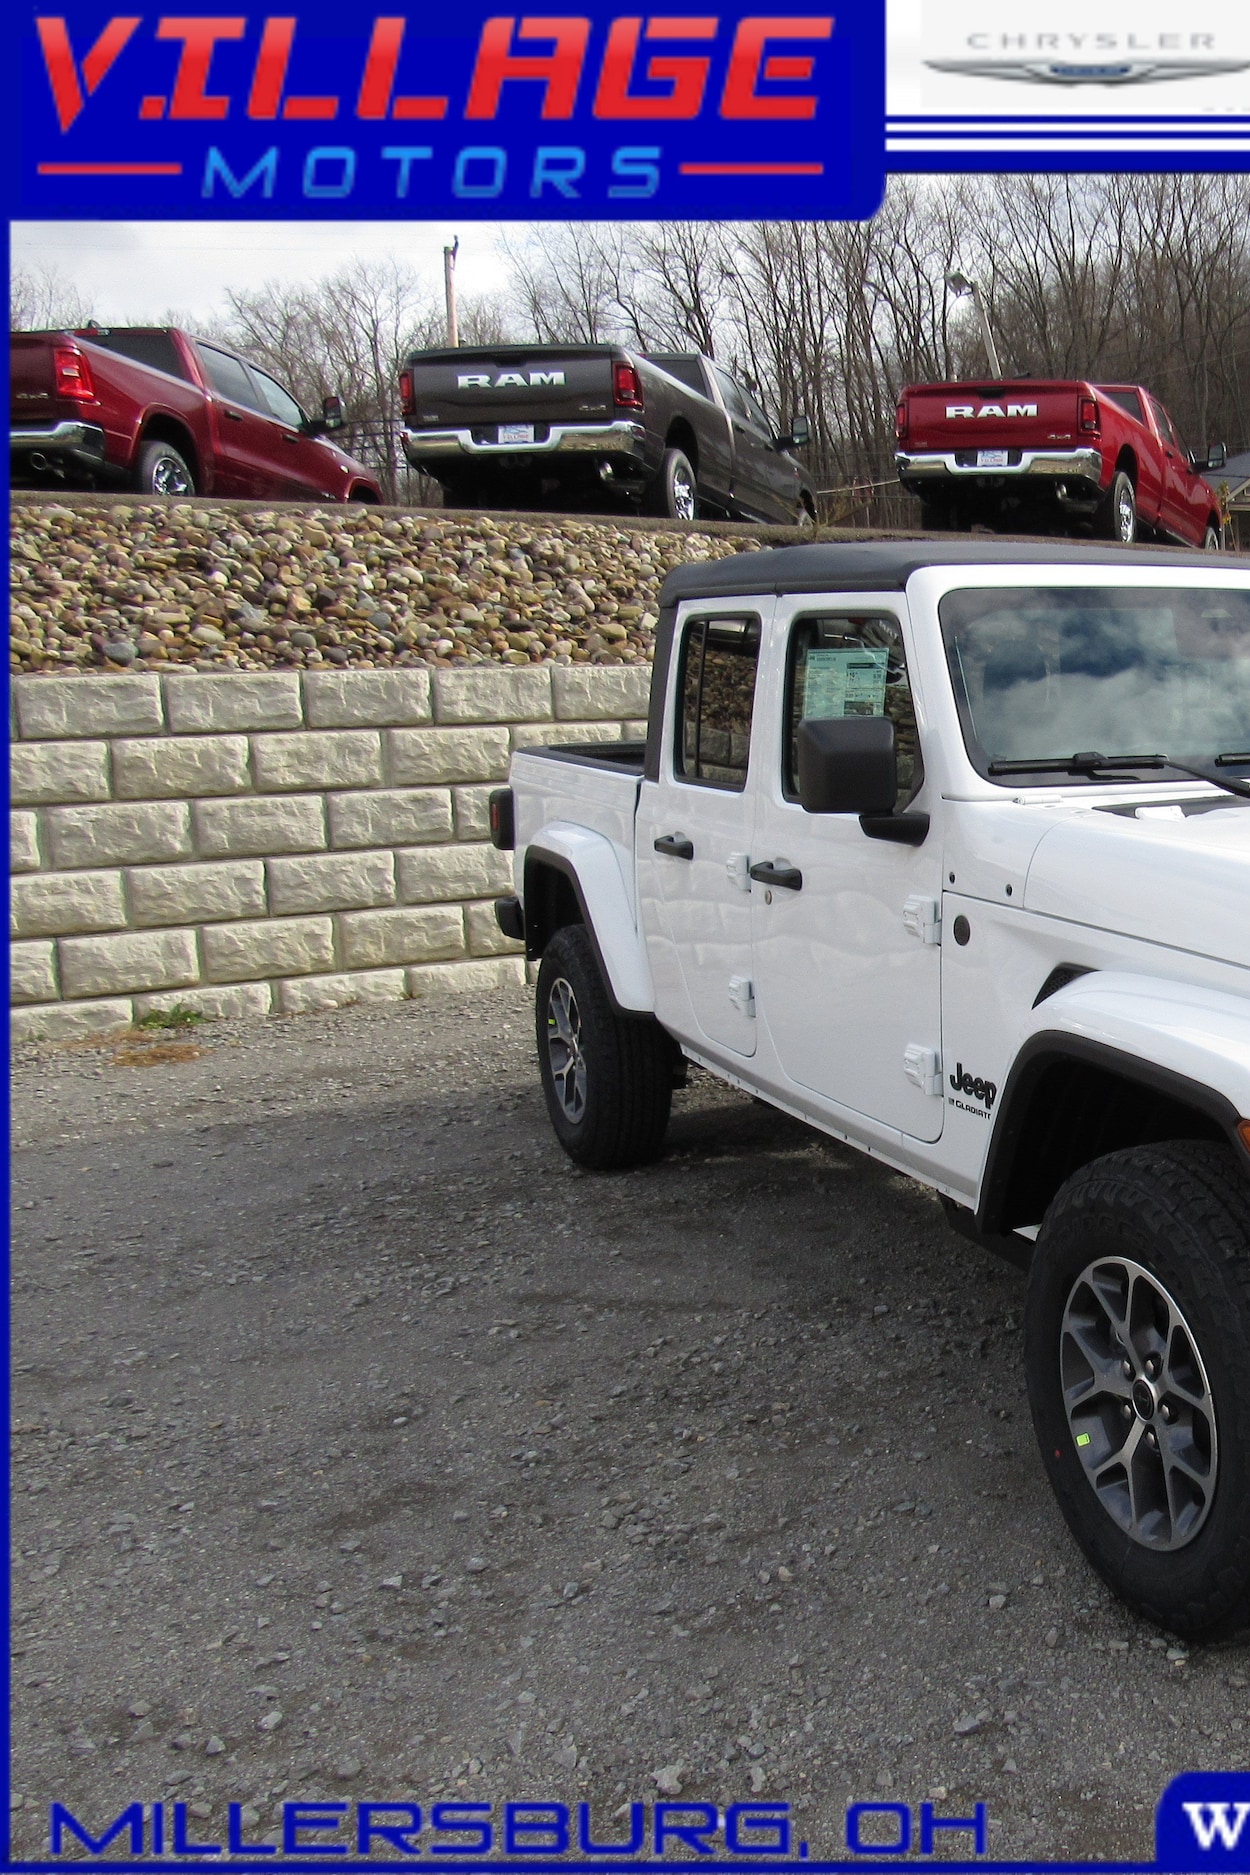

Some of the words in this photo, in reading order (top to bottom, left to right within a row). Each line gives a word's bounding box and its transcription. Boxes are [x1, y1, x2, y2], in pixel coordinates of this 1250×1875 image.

[458, 372, 566, 389] RAM
[946, 405, 1037, 418] RAM
[950, 1062, 997, 1109] Jeep
